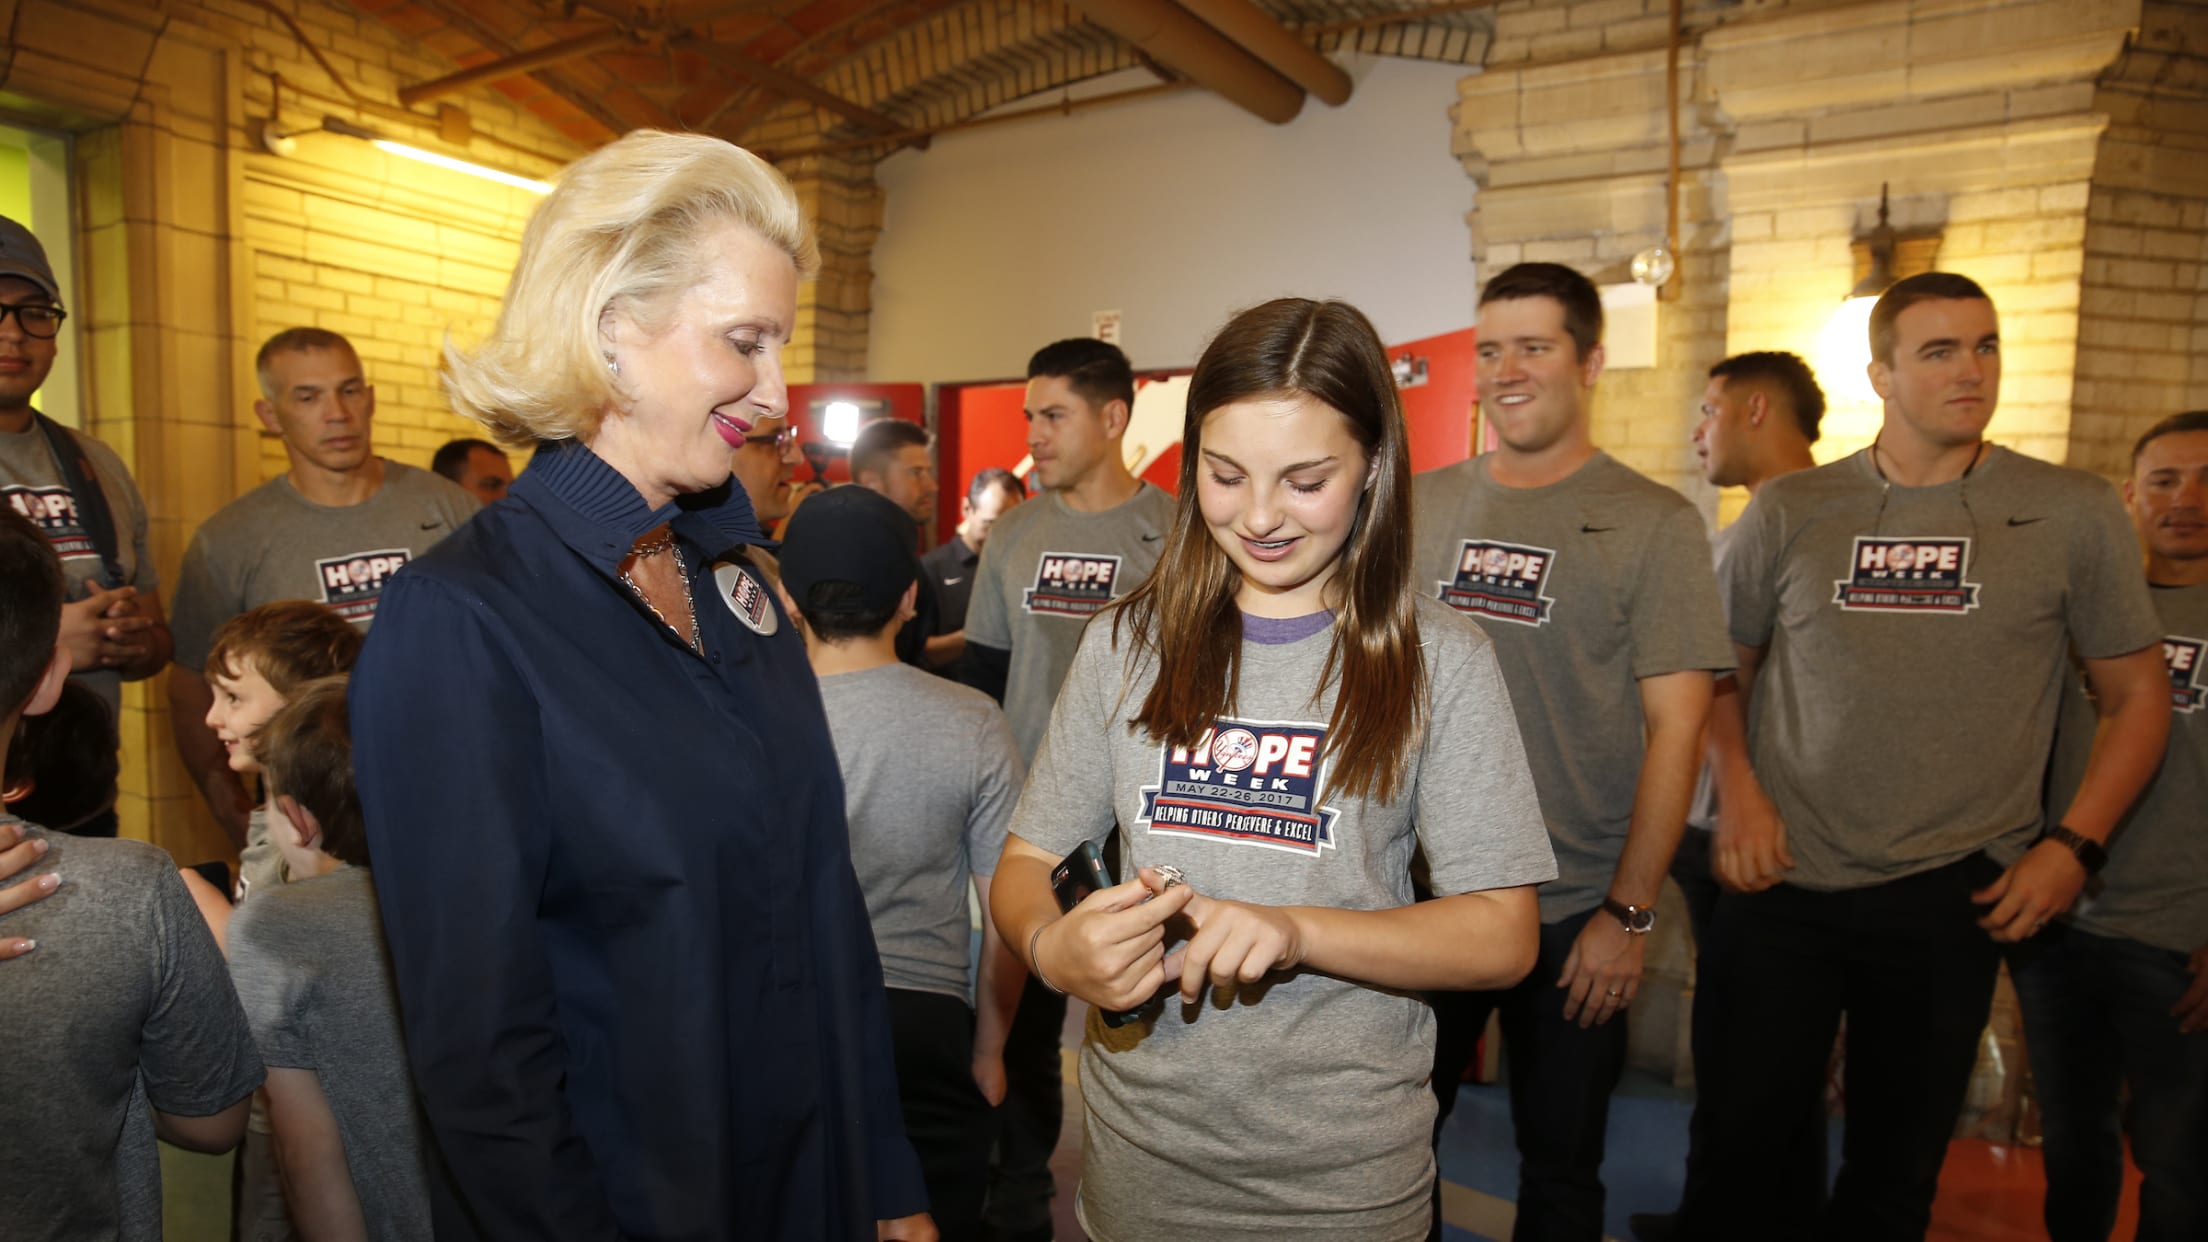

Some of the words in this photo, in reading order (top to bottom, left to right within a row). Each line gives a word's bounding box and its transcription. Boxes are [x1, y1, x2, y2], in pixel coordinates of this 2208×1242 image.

[1461, 547, 1545, 581] HOPE
[1859, 544, 1960, 571] HOPE
[1042, 559, 1114, 583] HOPE
[1871, 570, 1943, 579] WEEK
[1171, 725, 1318, 778] HOPE
[1189, 768, 1289, 791] WEEK
[1176, 783, 1206, 794] MAY
[1259, 792, 1293, 805] 2017
[1154, 806, 1189, 823] HELPING
[1191, 809, 1223, 827] OTHERS
[1224, 814, 1273, 834] PERSEVERE
[1274, 819, 1283, 835] &
[1284, 821, 1312, 841] EXCEL
